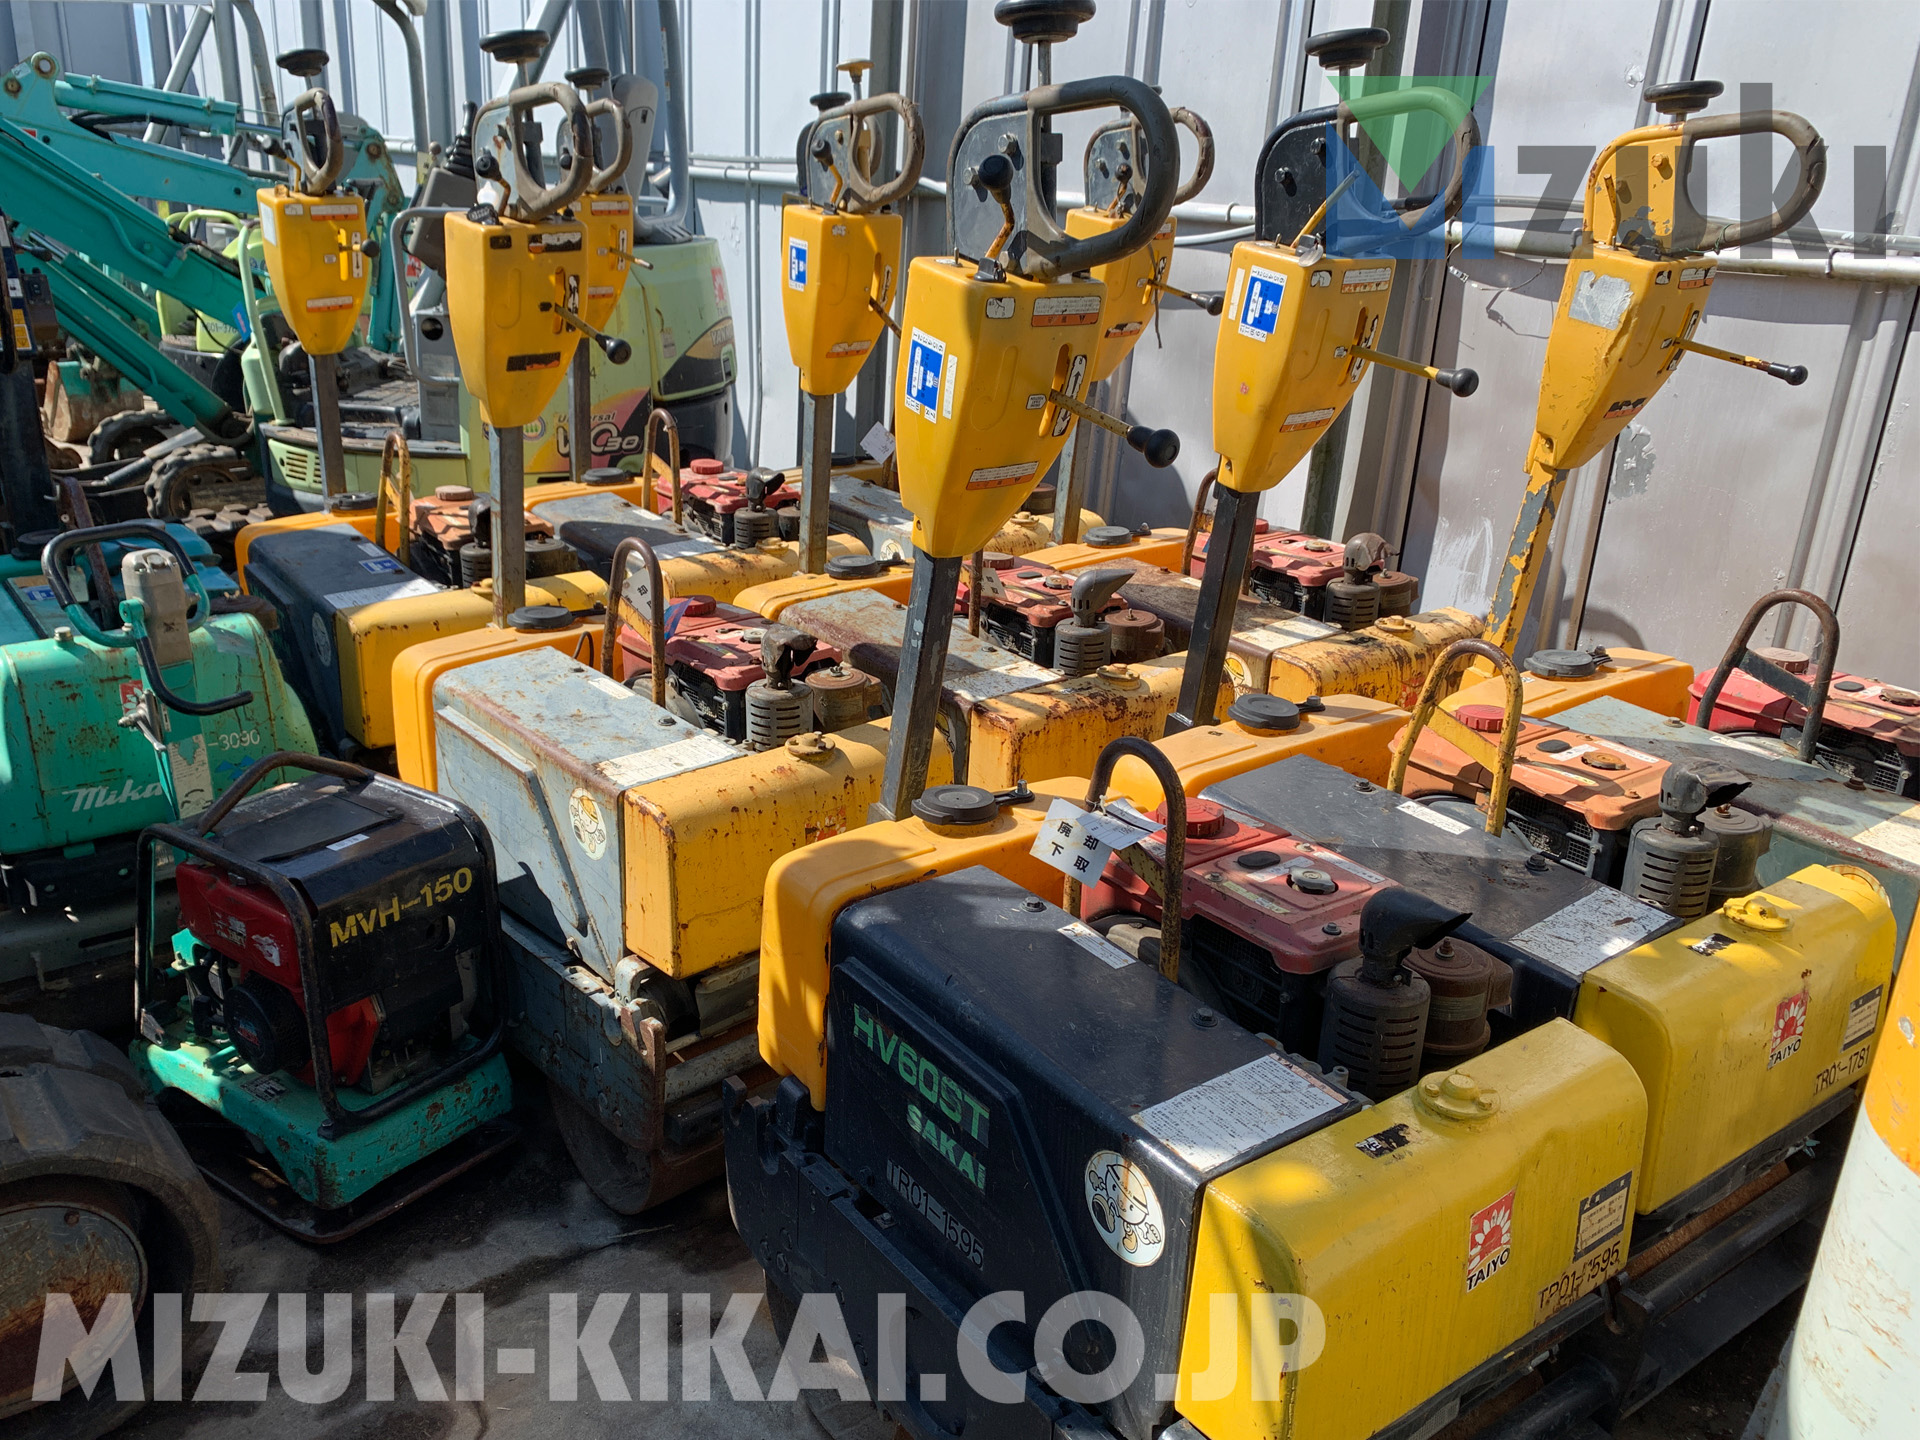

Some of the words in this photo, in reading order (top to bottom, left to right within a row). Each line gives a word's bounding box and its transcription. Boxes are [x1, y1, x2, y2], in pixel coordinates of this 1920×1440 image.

[558, 412, 616, 423] Ursal
[329, 867, 472, 948] MVH-150
[853, 1002, 990, 1140] HV60ST
[1769, 1039, 1802, 1065] TAIYO
[1466, 1247, 1511, 1291] TAIYO
